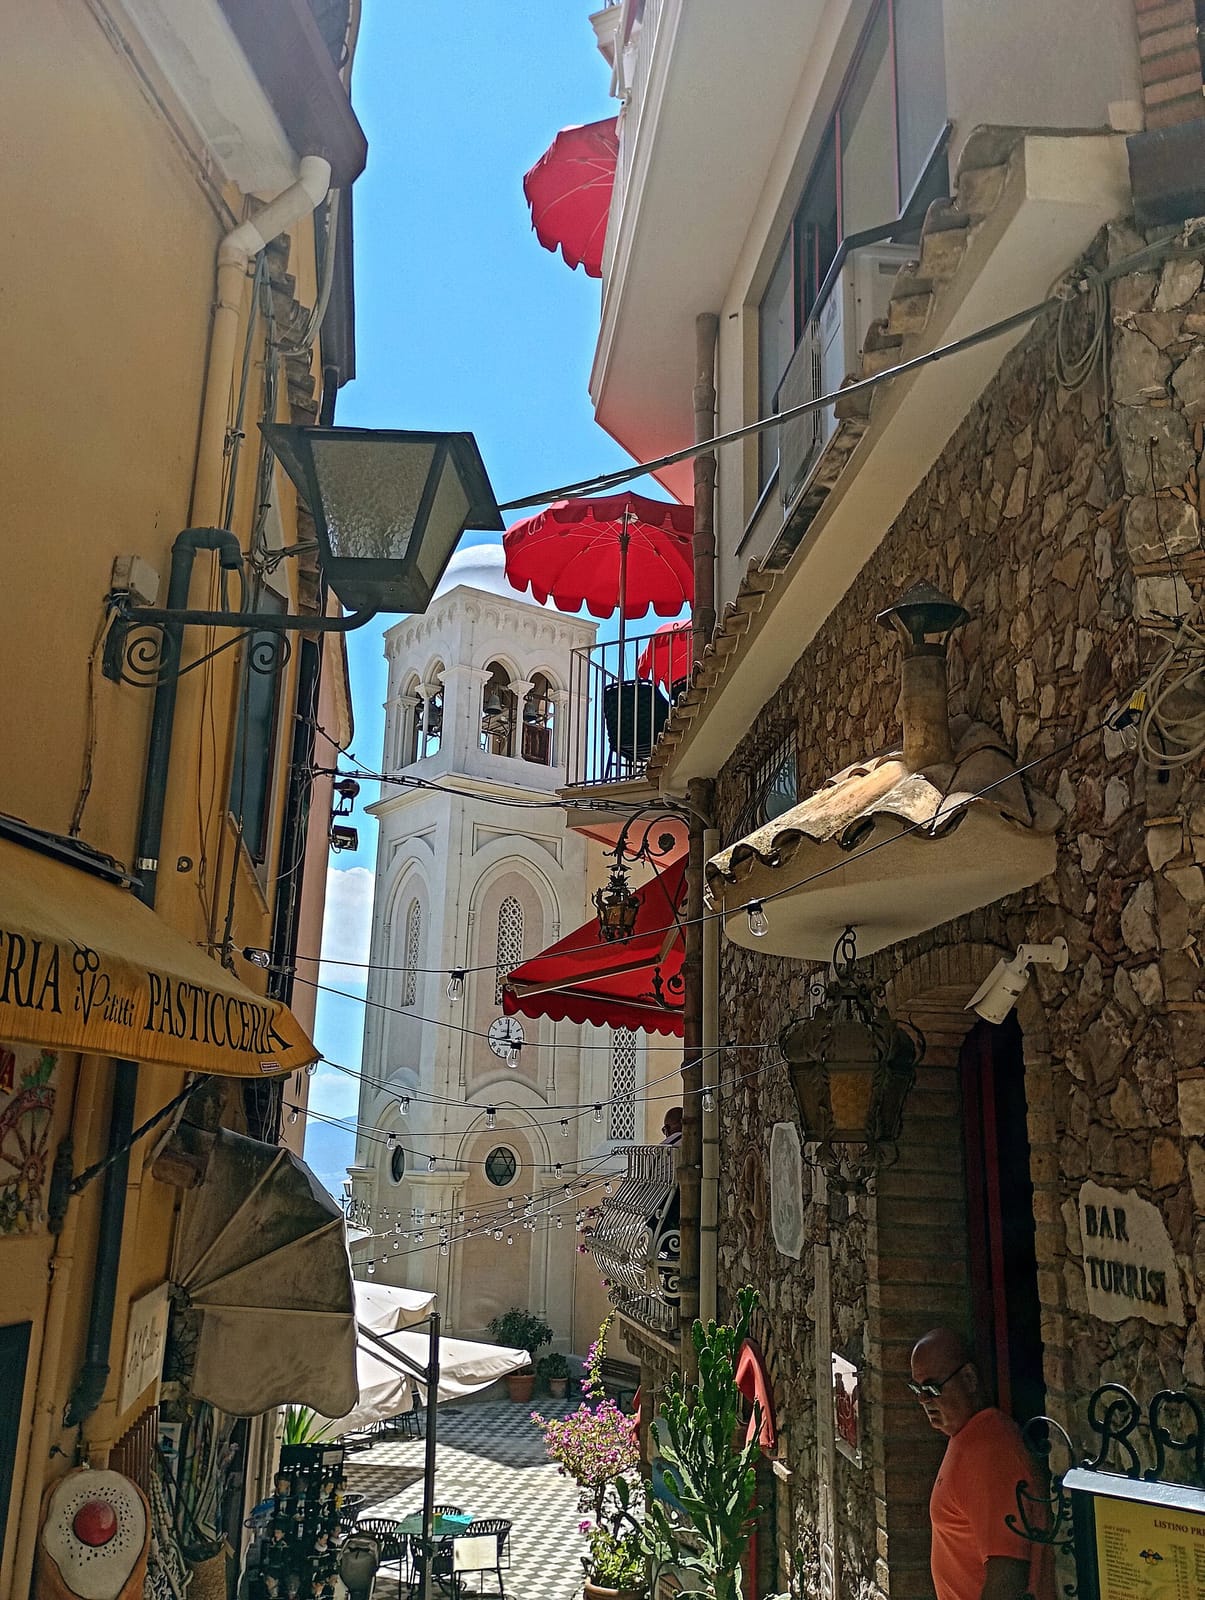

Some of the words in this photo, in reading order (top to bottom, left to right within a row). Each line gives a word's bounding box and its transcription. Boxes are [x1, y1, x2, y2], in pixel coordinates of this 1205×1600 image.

[0, 929, 62, 1015] RIA
[144, 971, 293, 1054] PASTICCERIA
[1085, 1205, 1129, 1242] BAR
[1154, 1519, 1188, 1533] LISTINO
